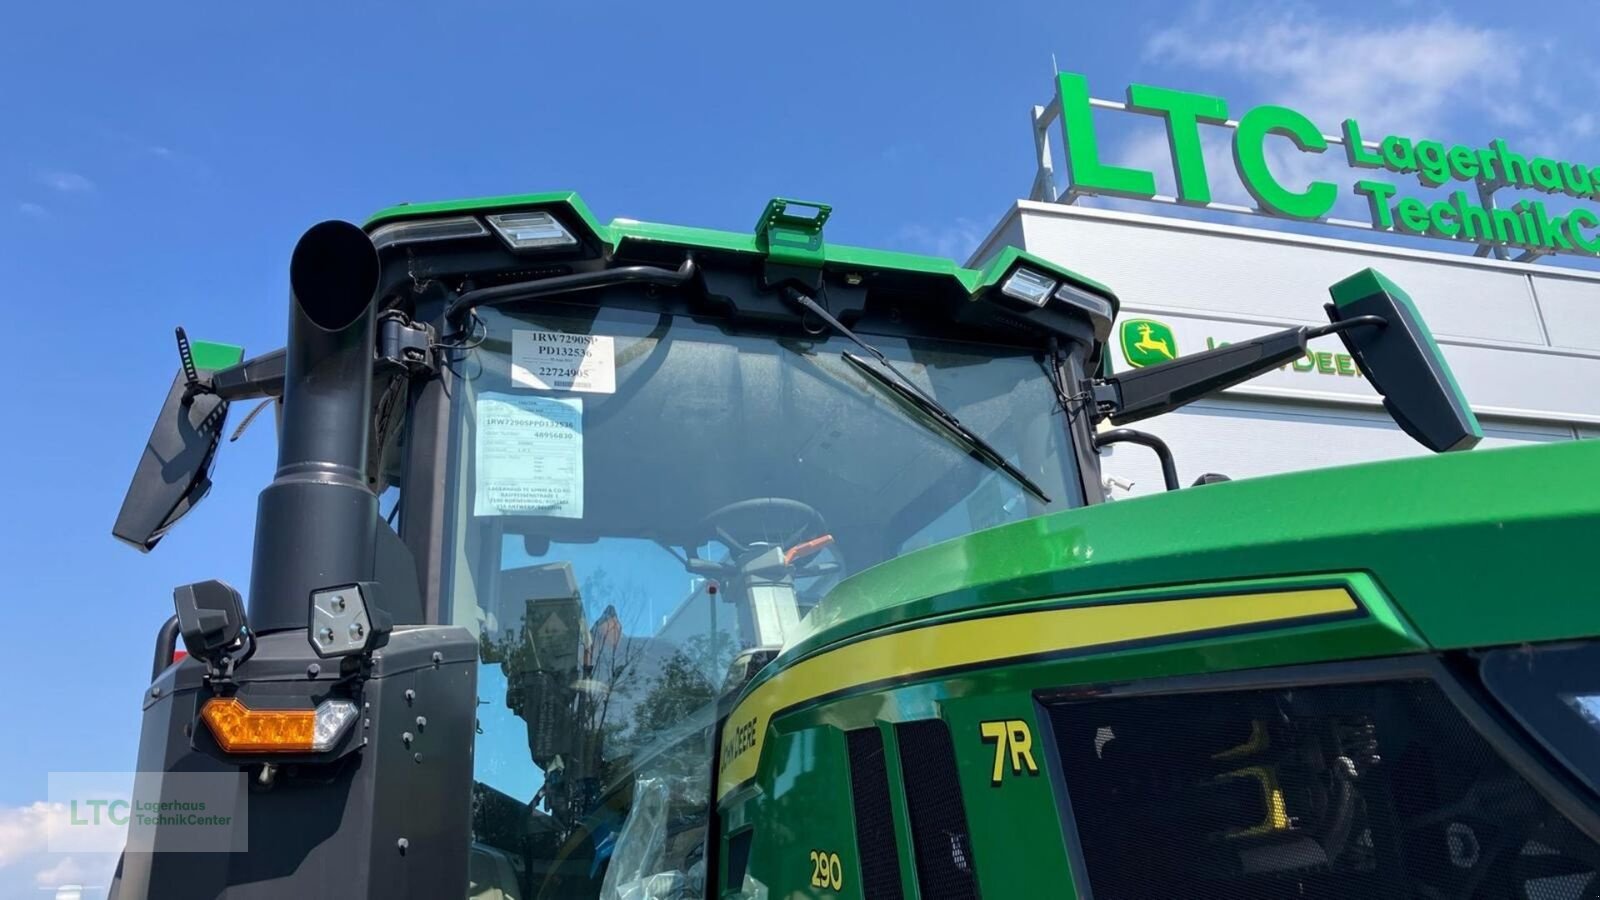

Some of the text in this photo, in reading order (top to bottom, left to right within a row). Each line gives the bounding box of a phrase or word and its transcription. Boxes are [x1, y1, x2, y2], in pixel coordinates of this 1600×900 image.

[1056, 72, 1337, 219] LTC
[532, 333, 598, 345] 1RW7290SP
[538, 346, 592, 358] PD132536
[539, 366, 590, 378] 22724905
[1293, 347, 1362, 377] DEE
[735, 716, 758, 759] DEERE
[980, 719, 1039, 787] 7R
[810, 850, 842, 890] 290
